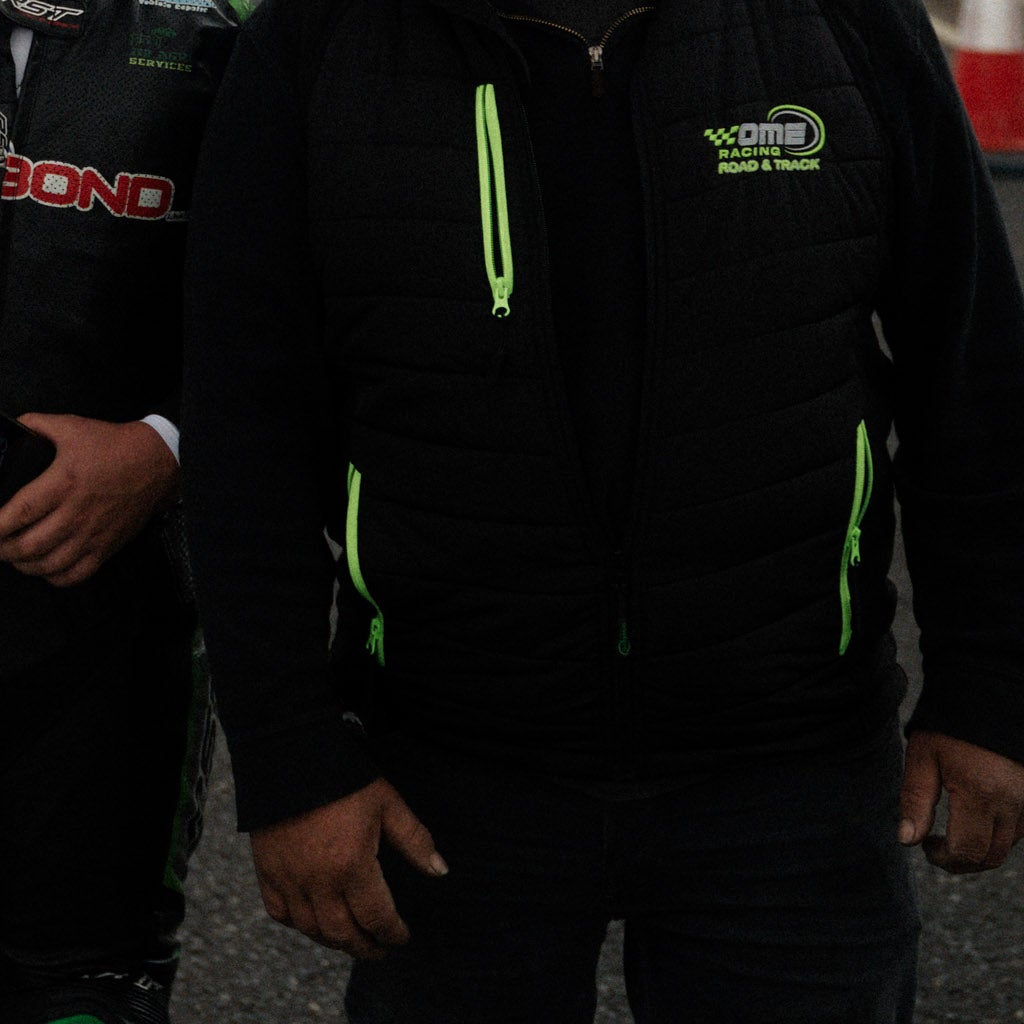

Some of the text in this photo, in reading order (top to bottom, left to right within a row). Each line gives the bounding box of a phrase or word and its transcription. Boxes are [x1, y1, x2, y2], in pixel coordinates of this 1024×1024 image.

[128, 57, 193, 72] SERVICES
[718, 146, 781, 160] RACING
[718, 158, 821, 174] ROAD & TRACK
